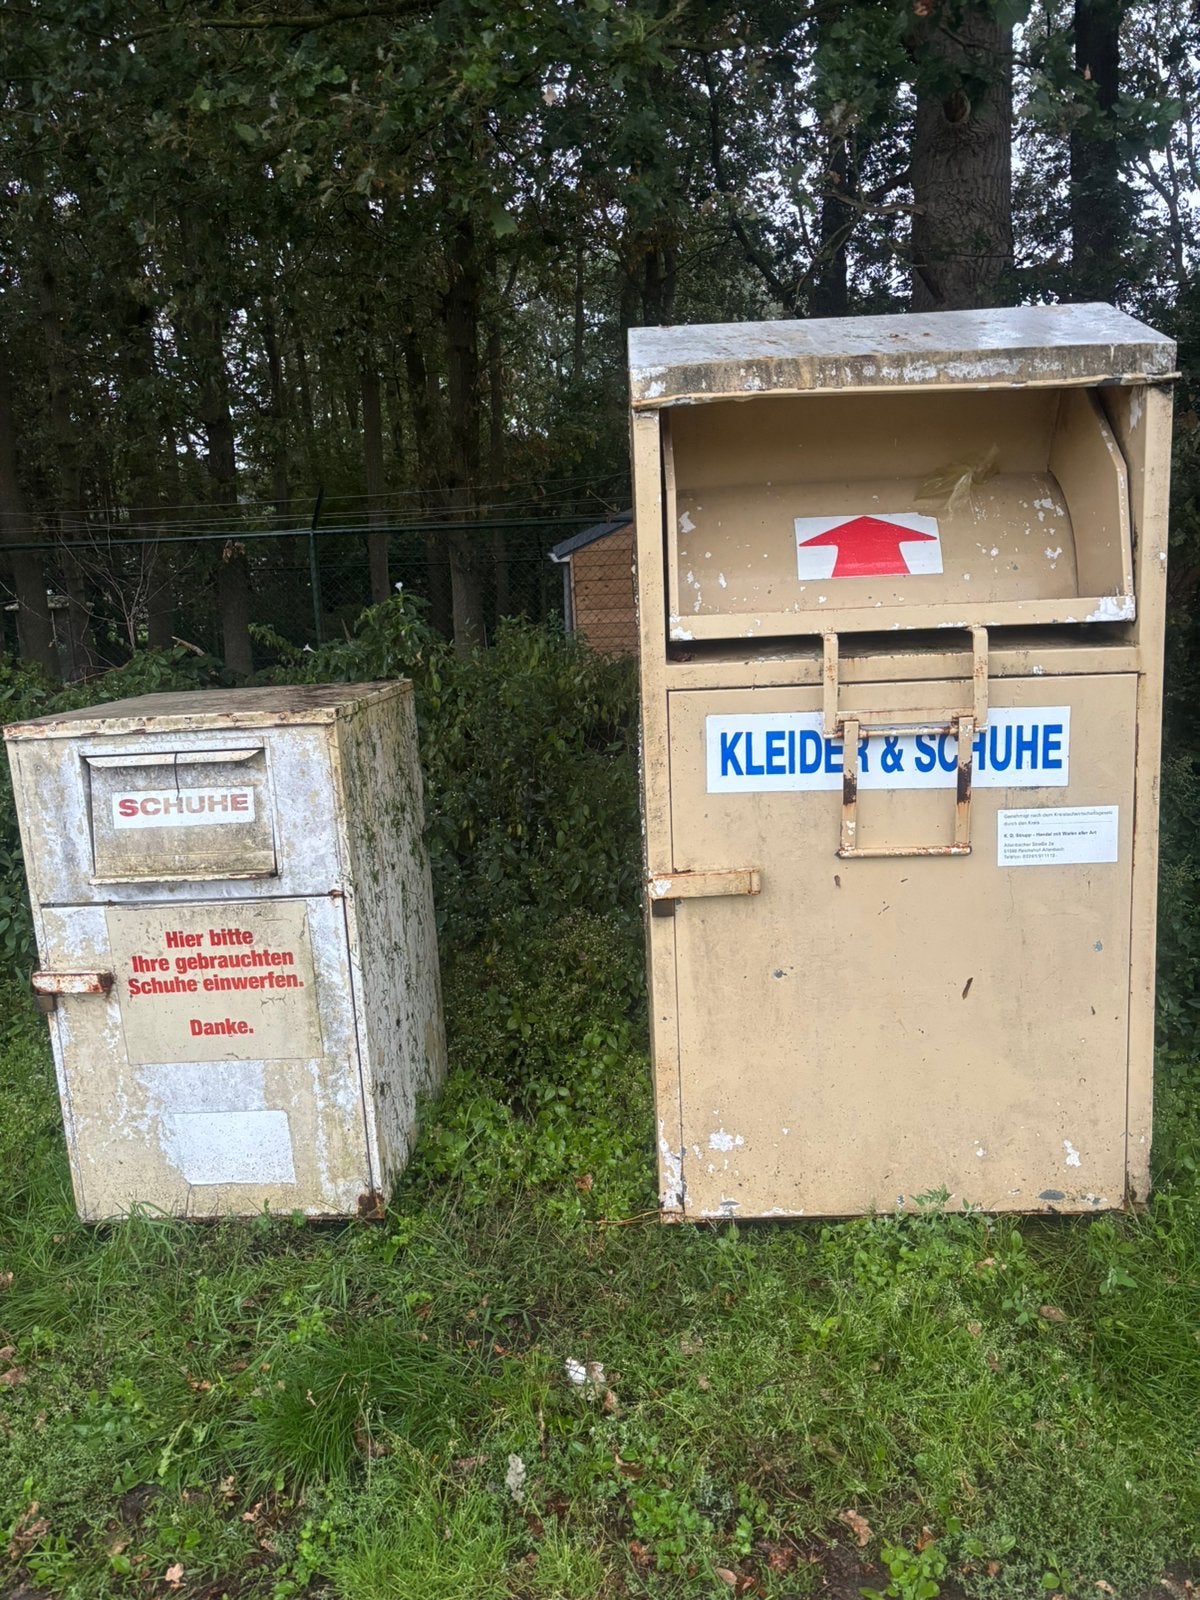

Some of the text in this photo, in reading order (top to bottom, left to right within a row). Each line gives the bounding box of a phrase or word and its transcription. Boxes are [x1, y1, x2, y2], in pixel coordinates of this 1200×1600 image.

[881, 734, 904, 773] &
[914, 724, 1063, 773] SCHUHE
[118, 793, 249, 817] SCHUHE
[165, 928, 254, 948] Hier bitte
[131, 949, 294, 974] Ihre gebrauchten
[128, 971, 304, 995] Schuhe einwerfen.
[189, 1018, 254, 1036] Danke.
